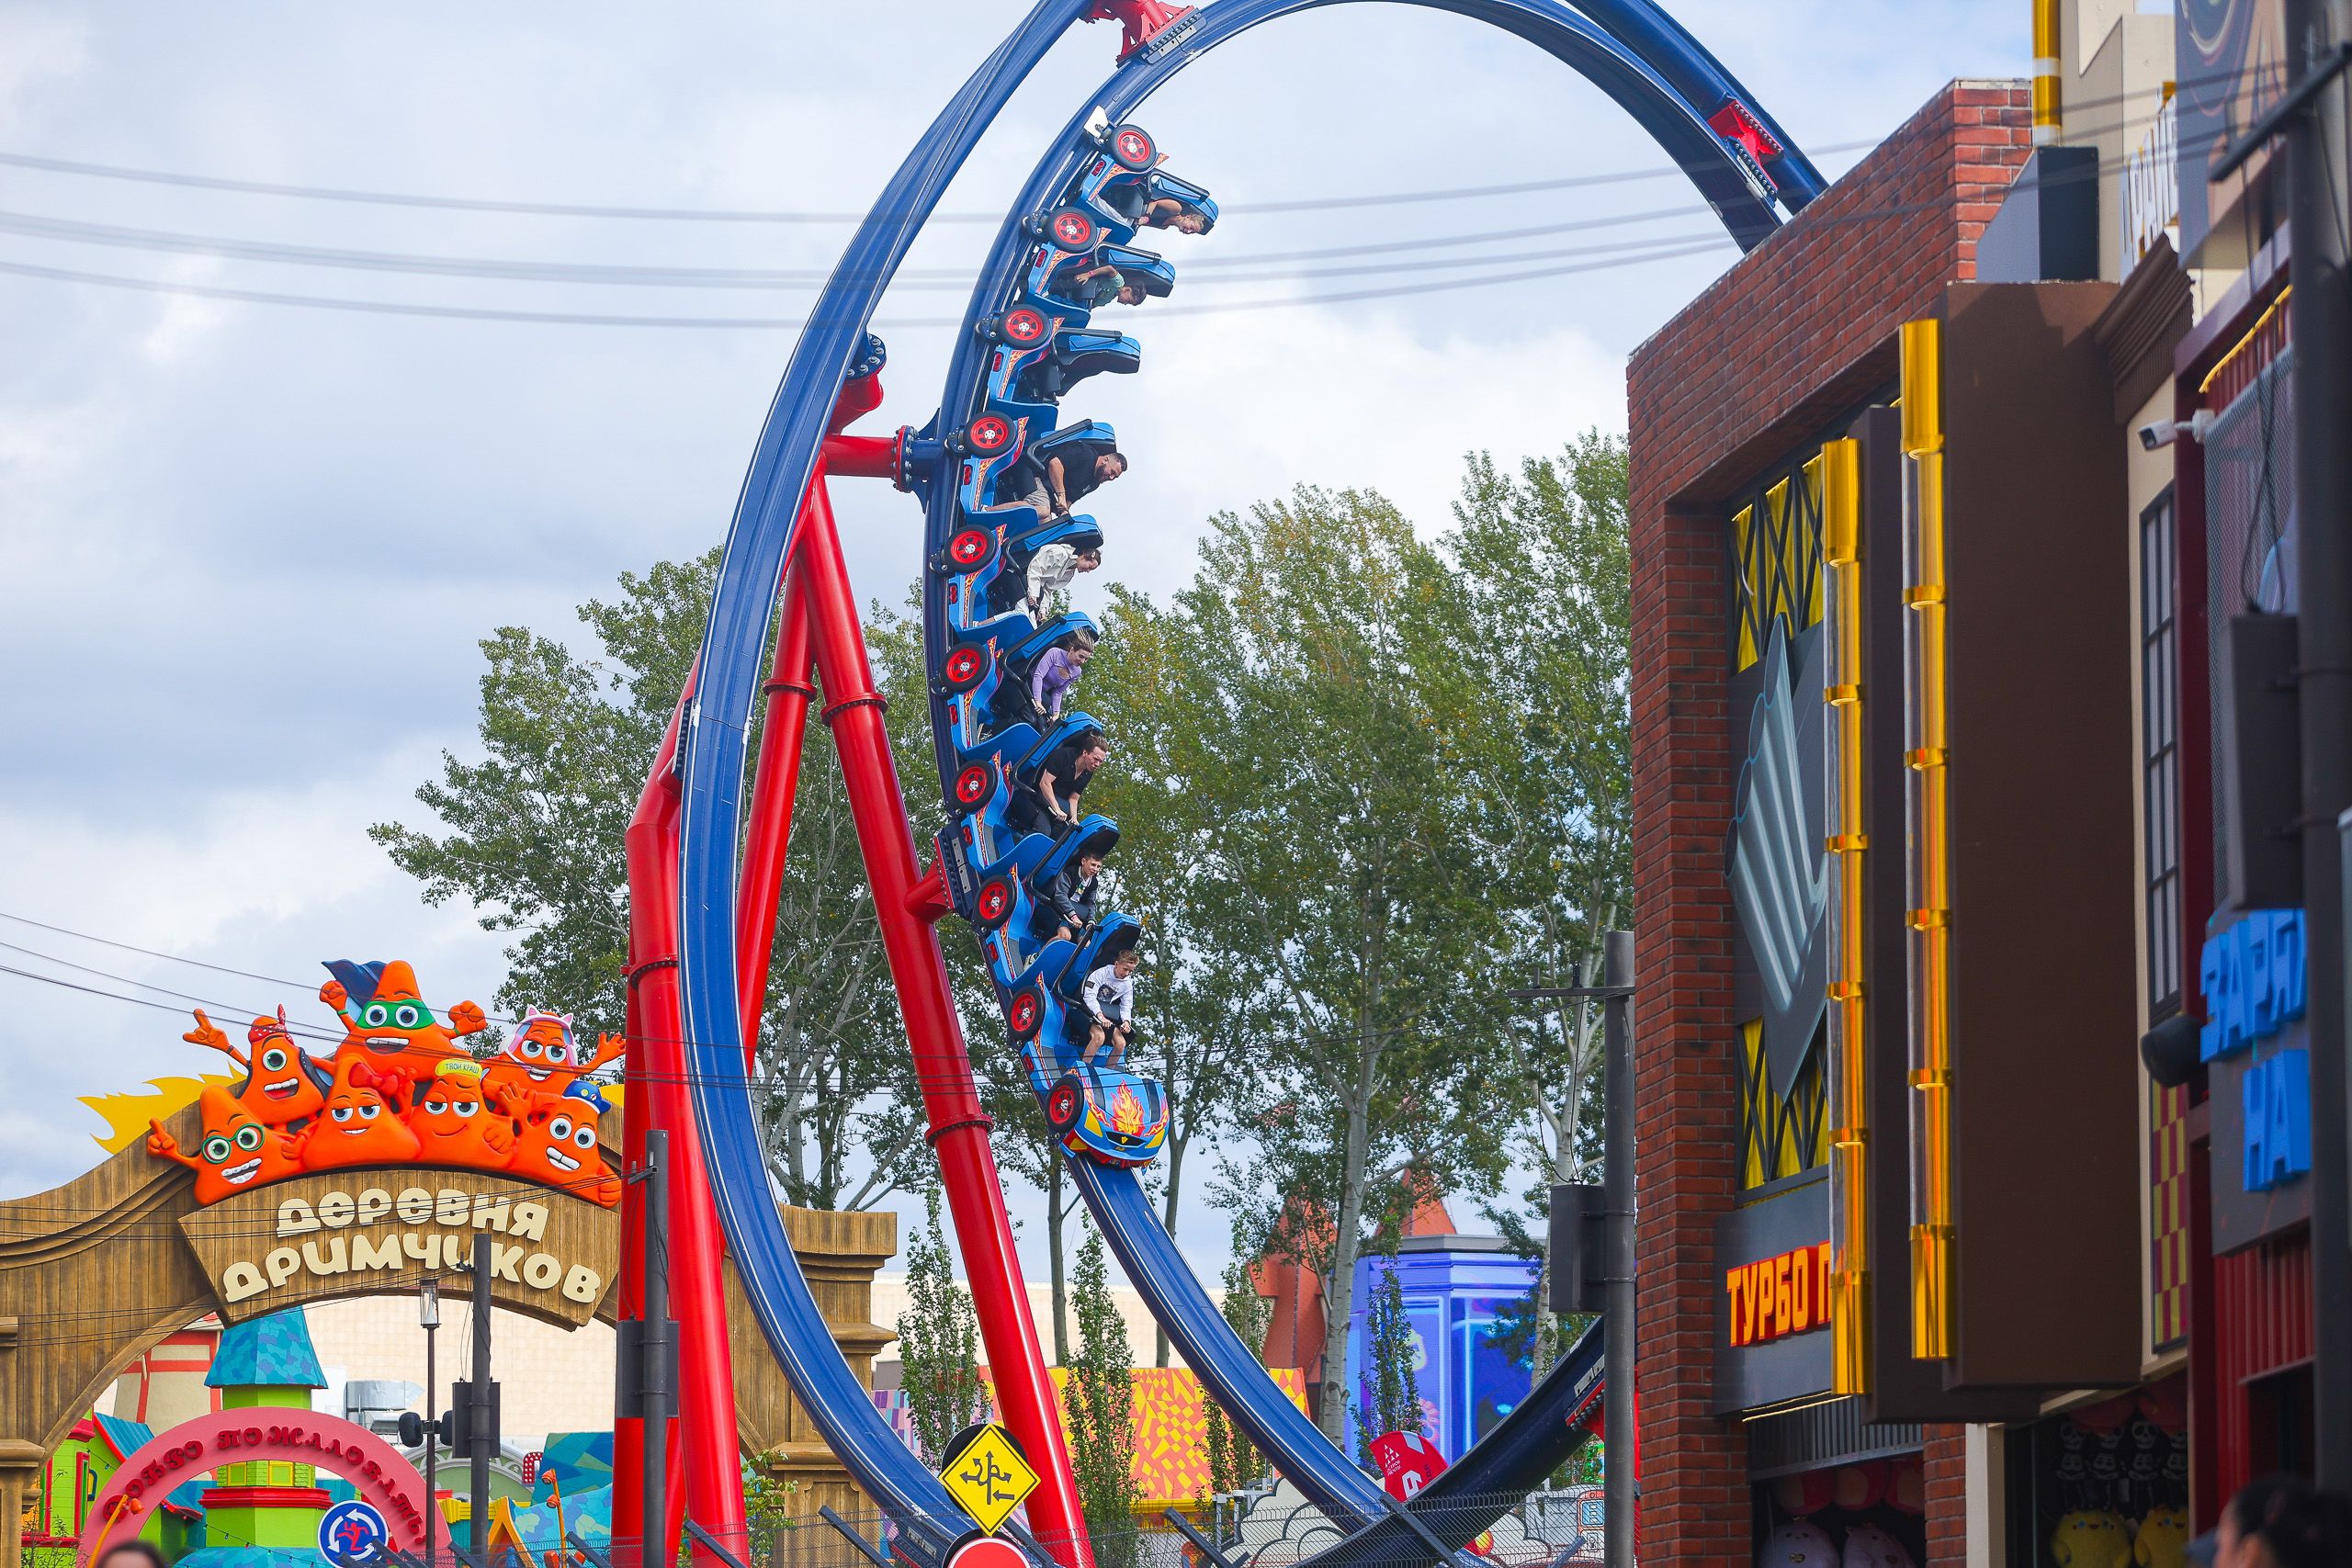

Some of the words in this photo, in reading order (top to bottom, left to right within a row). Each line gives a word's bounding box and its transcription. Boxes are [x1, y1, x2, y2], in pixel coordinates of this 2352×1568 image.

[277, 1188, 549, 1242] ДЕРЕВНЯ
[223, 1233, 601, 1303] ДРИМЧИКОВ
[1727, 1247, 1810, 1347] ТУРБО
